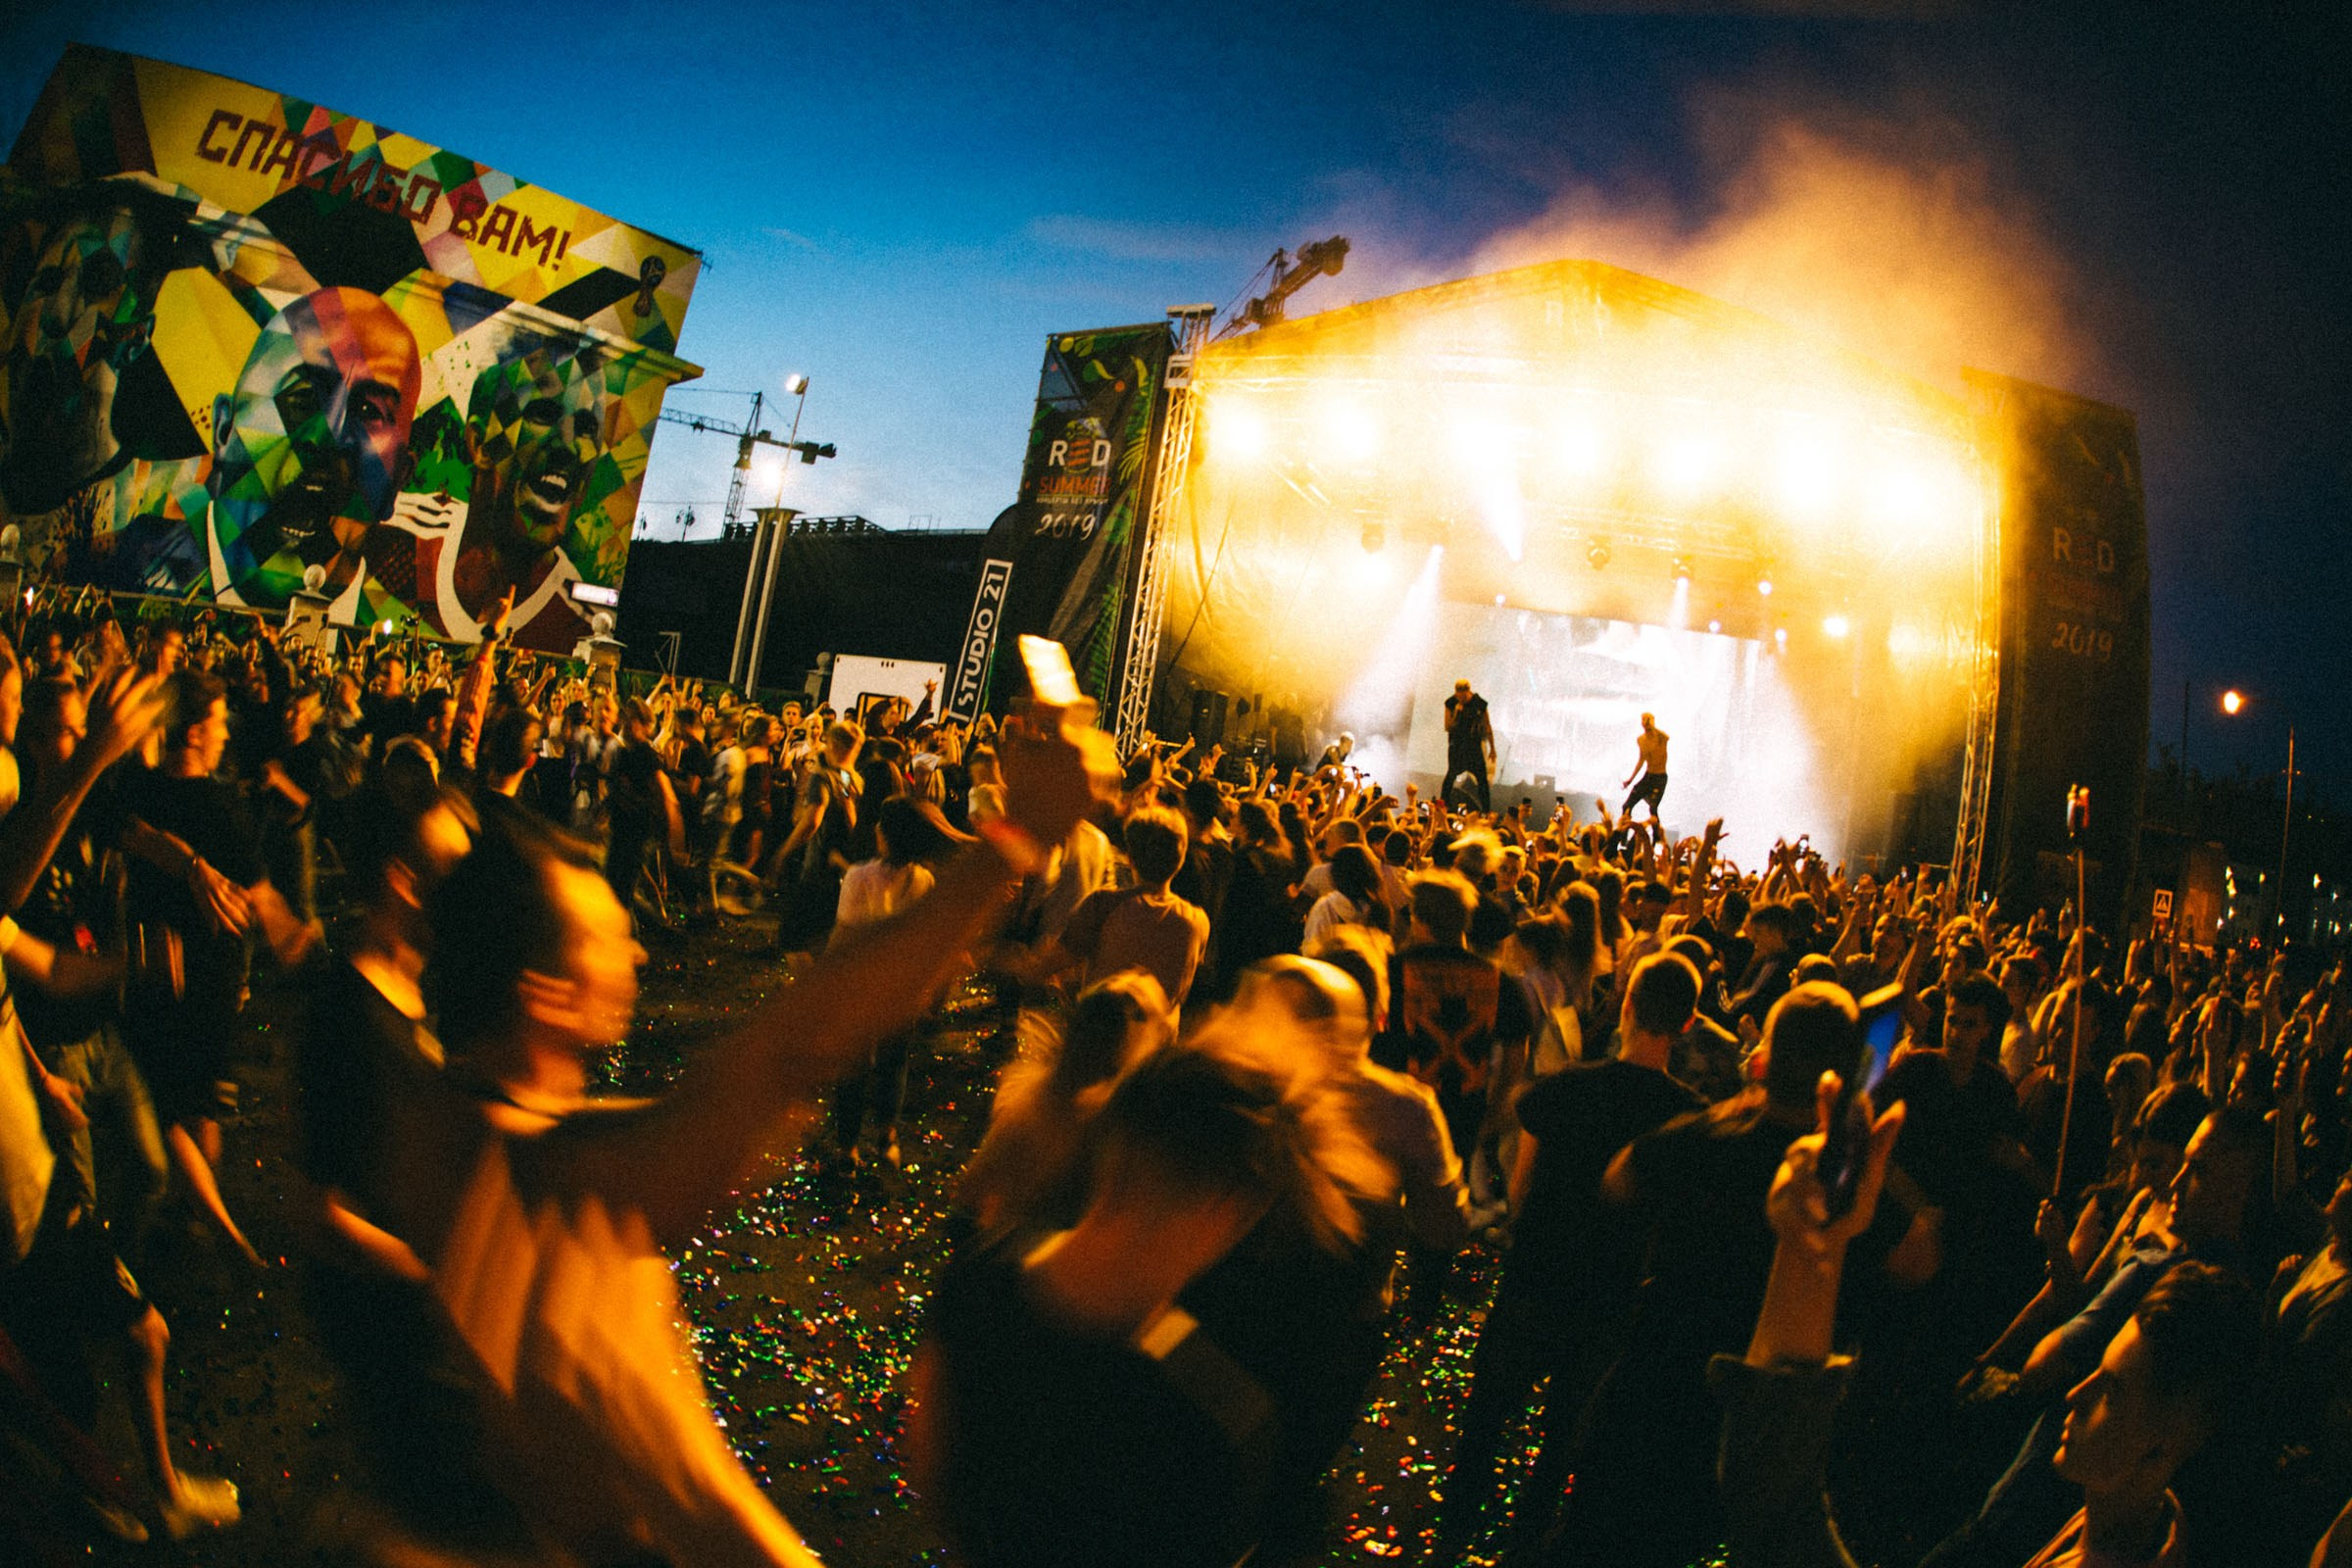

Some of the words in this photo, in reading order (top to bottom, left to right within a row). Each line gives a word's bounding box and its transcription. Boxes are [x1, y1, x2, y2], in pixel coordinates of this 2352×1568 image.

[196, 108, 442, 225] СПАСИБО
[451, 193, 571, 271] ВАМ!
[1049, 438, 1111, 466] RED
[1035, 514, 1096, 541] 2019
[957, 608, 994, 707] STUDIO
[983, 572, 1004, 602] 21
[2052, 621, 2114, 662] 2019
